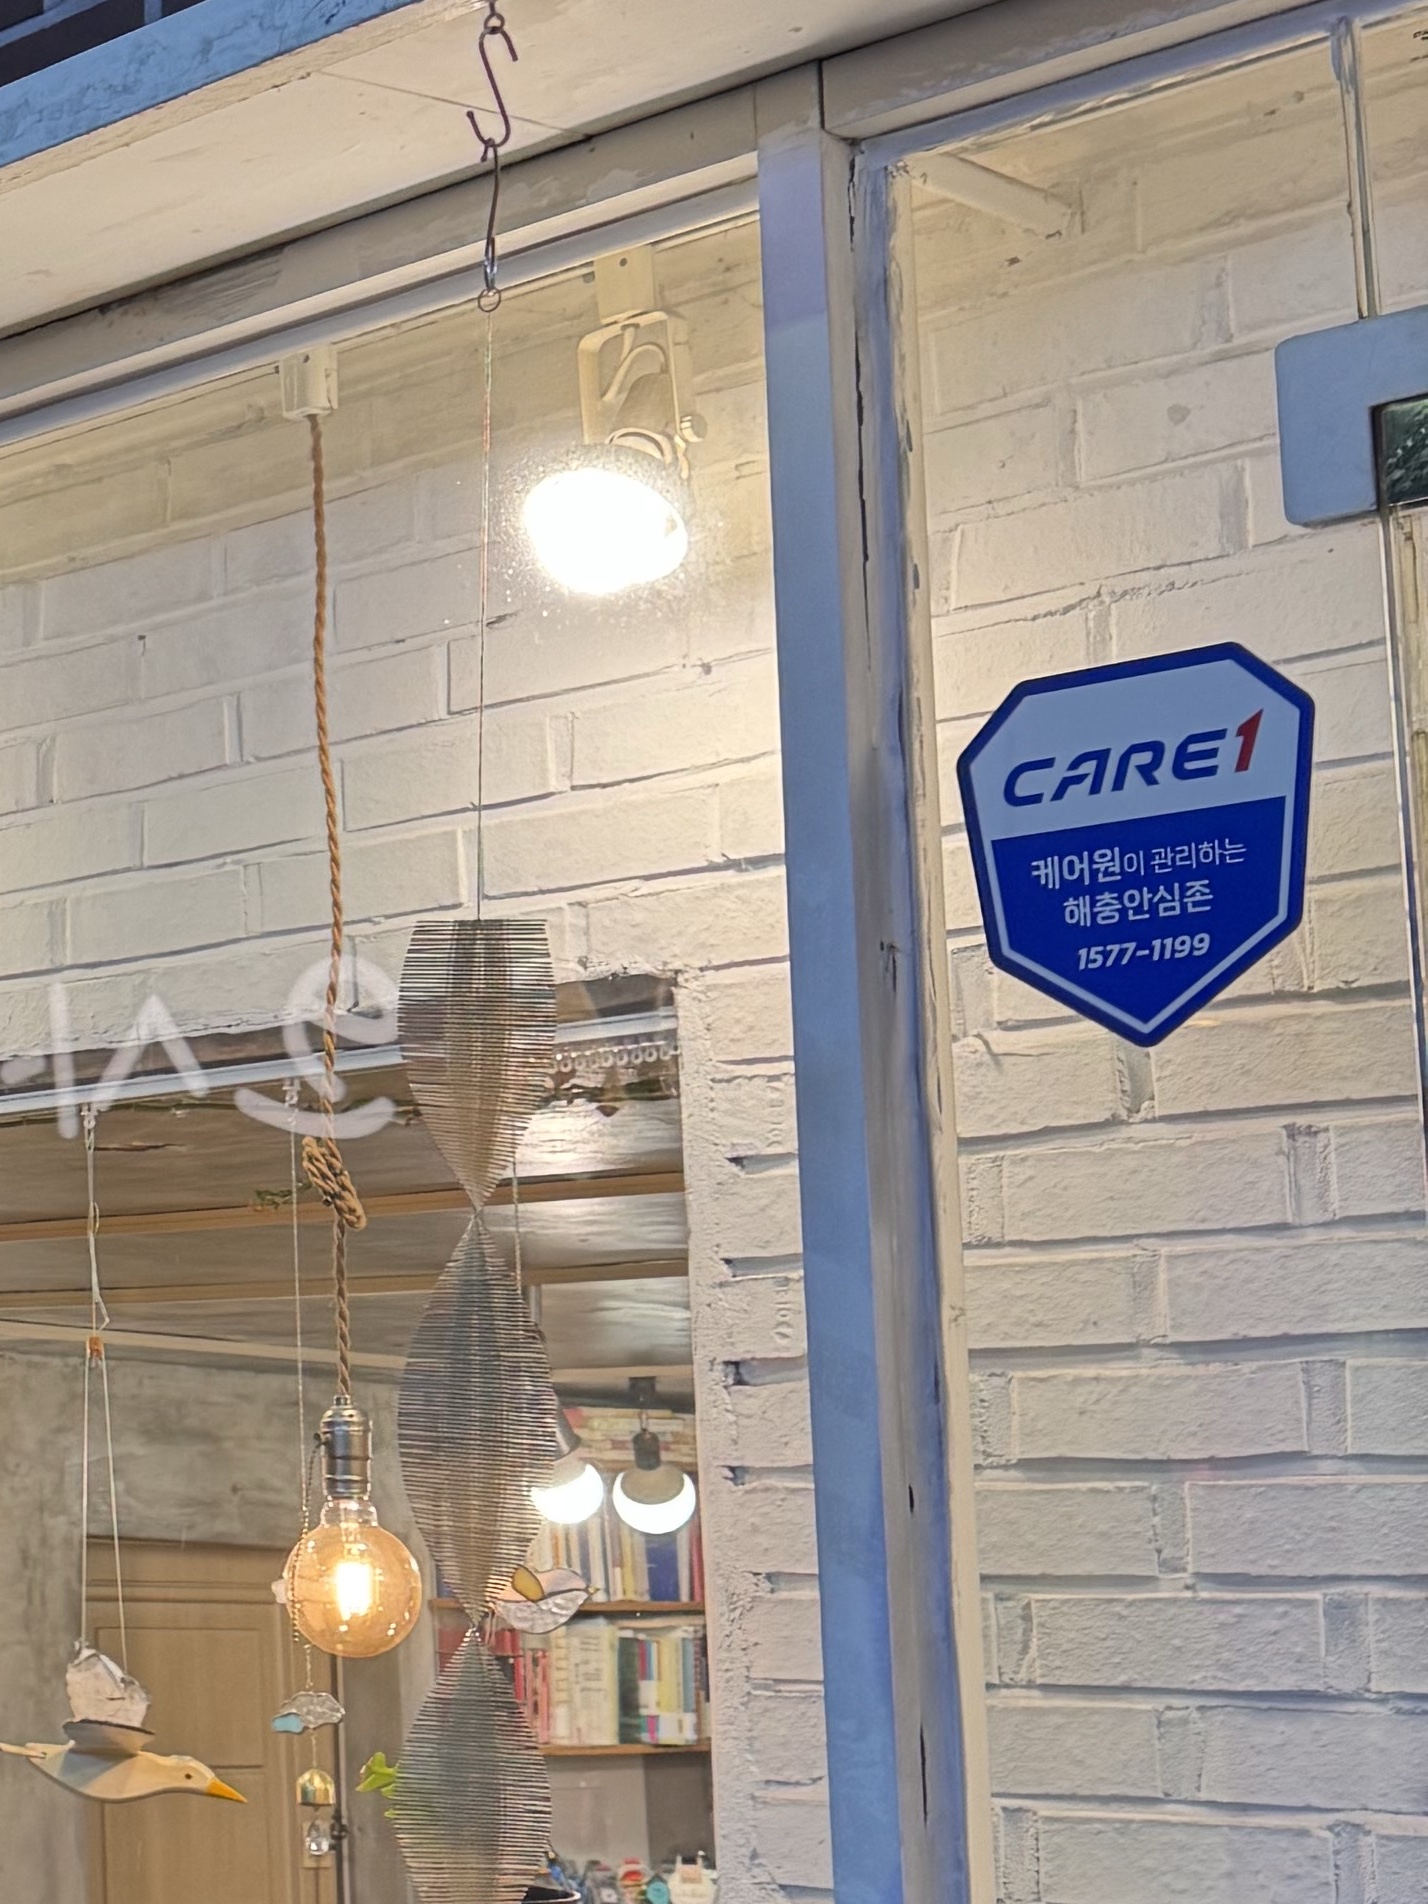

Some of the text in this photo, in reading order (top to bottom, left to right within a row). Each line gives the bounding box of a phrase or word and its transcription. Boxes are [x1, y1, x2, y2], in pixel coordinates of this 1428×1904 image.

[1002, 707, 1264, 808] CARE1
[1030, 837, 1248, 891] 케어원이 관리하는
[1062, 878, 1214, 929] 해충안심존
[1075, 931, 1212, 972] 1577-1199
